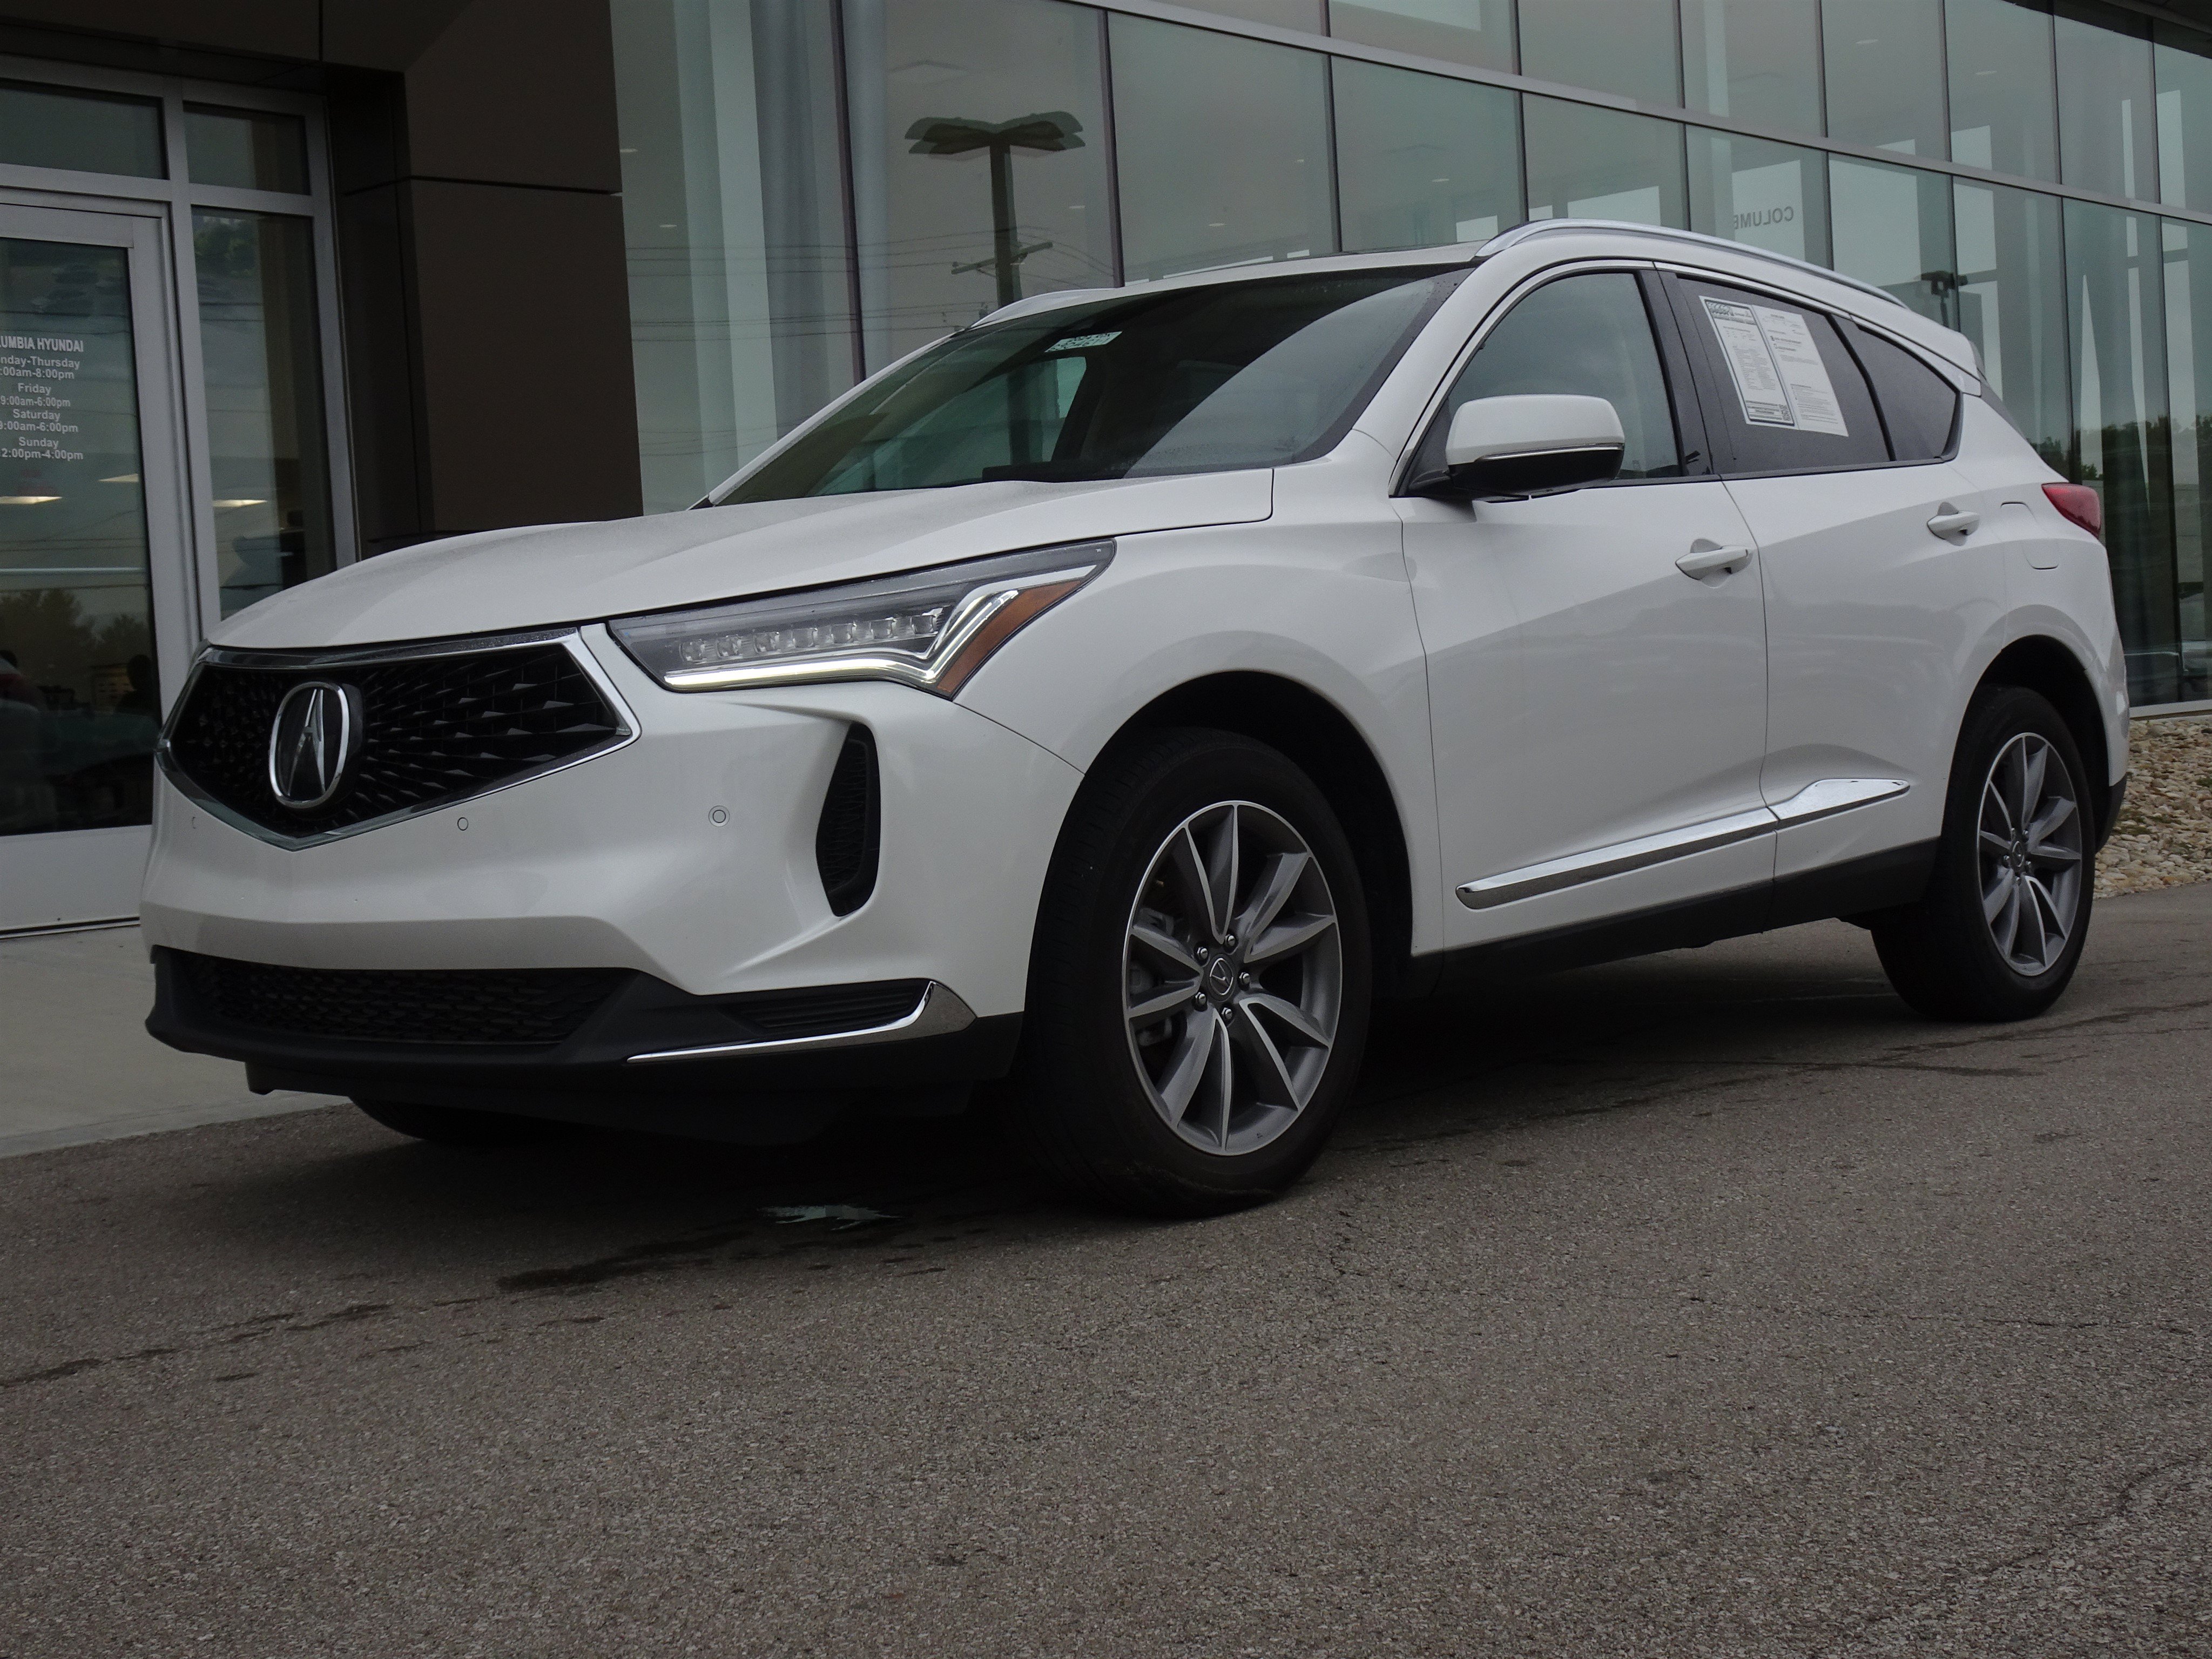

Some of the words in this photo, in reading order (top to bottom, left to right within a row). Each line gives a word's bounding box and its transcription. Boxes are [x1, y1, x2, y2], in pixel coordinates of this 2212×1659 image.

[0, 335, 35, 350] UMBIA
[37, 338, 84, 352] HYUNDAI
[17, 382, 51, 395] Friday
[0, 395, 71, 408] 9:00am-6:00pm
[13, 408, 60, 422] Saturday
[18, 436, 59, 449] Sunday
[0, 447, 83, 461] 2:00pm-4:00pm
